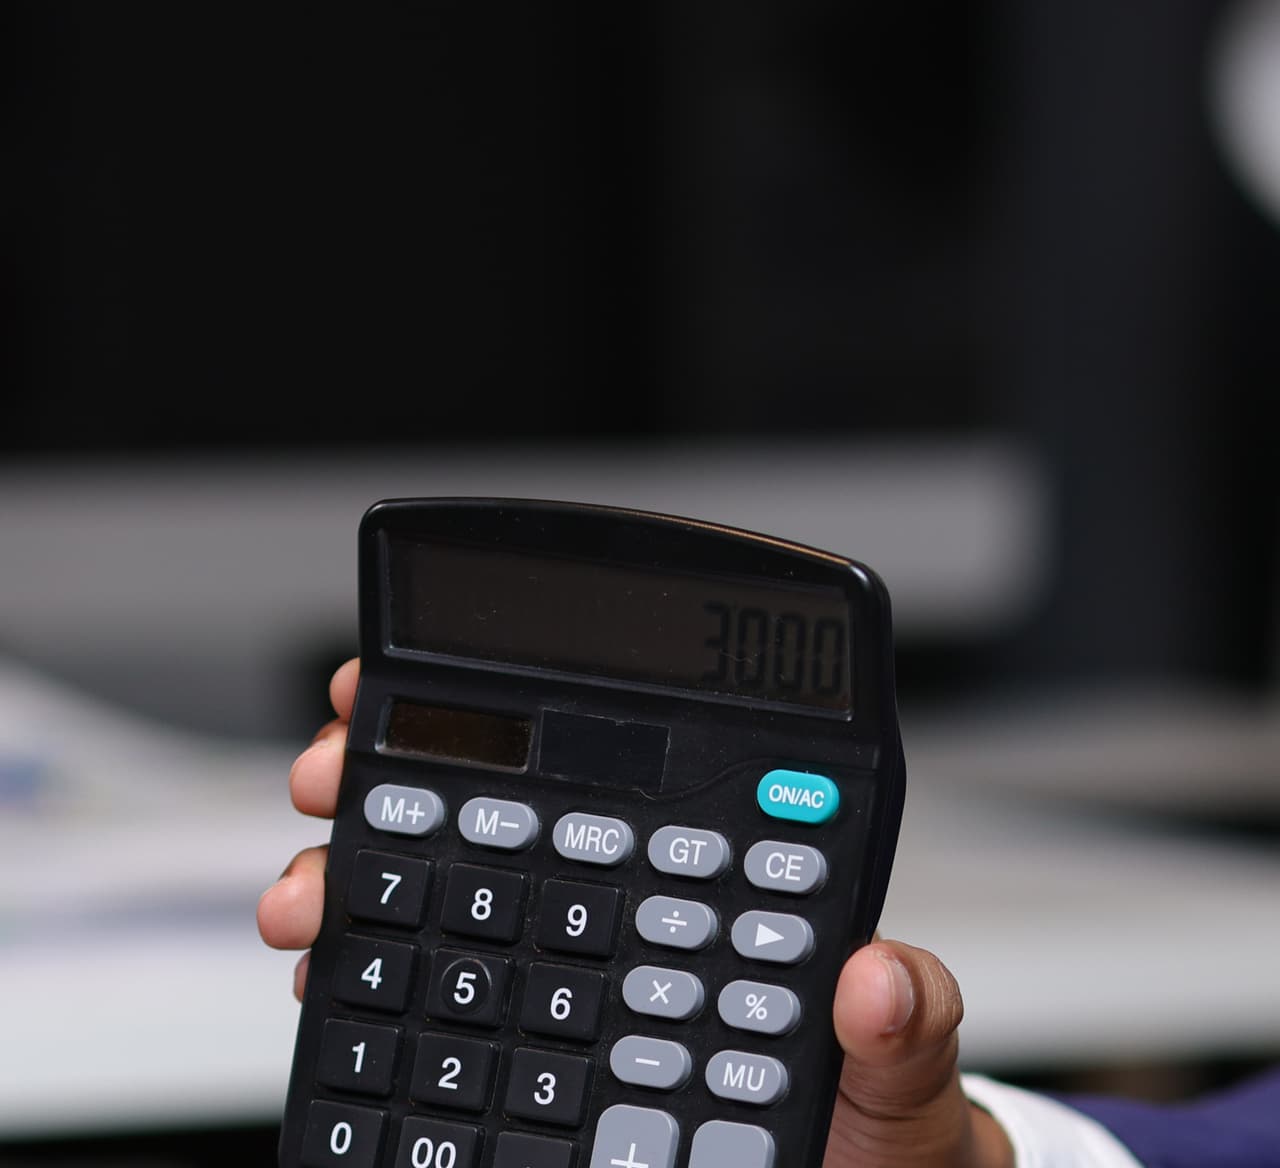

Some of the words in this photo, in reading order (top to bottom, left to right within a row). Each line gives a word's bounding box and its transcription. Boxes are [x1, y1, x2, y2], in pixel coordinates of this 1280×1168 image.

[702, 601, 847, 694] 3000
[382, 797, 426, 824] M+
[769, 785, 824, 808] ON/AC
[565, 825, 619, 855] MRC
[670, 837, 708, 864] GT
[766, 851, 803, 880] CE
[381, 873, 401, 903] 7
[472, 889, 492, 920] 8
[567, 905, 587, 936] 9
[362, 959, 381, 988] 4
[454, 972, 477, 1004] 5
[551, 988, 572, 1019] 6
[745, 993, 768, 1019] %
[353, 1043, 365, 1072] 1
[439, 1058, 461, 1089] 2
[535, 1073, 555, 1104] 3
[722, 1062, 766, 1091] MU
[331, 1122, 351, 1154] 0
